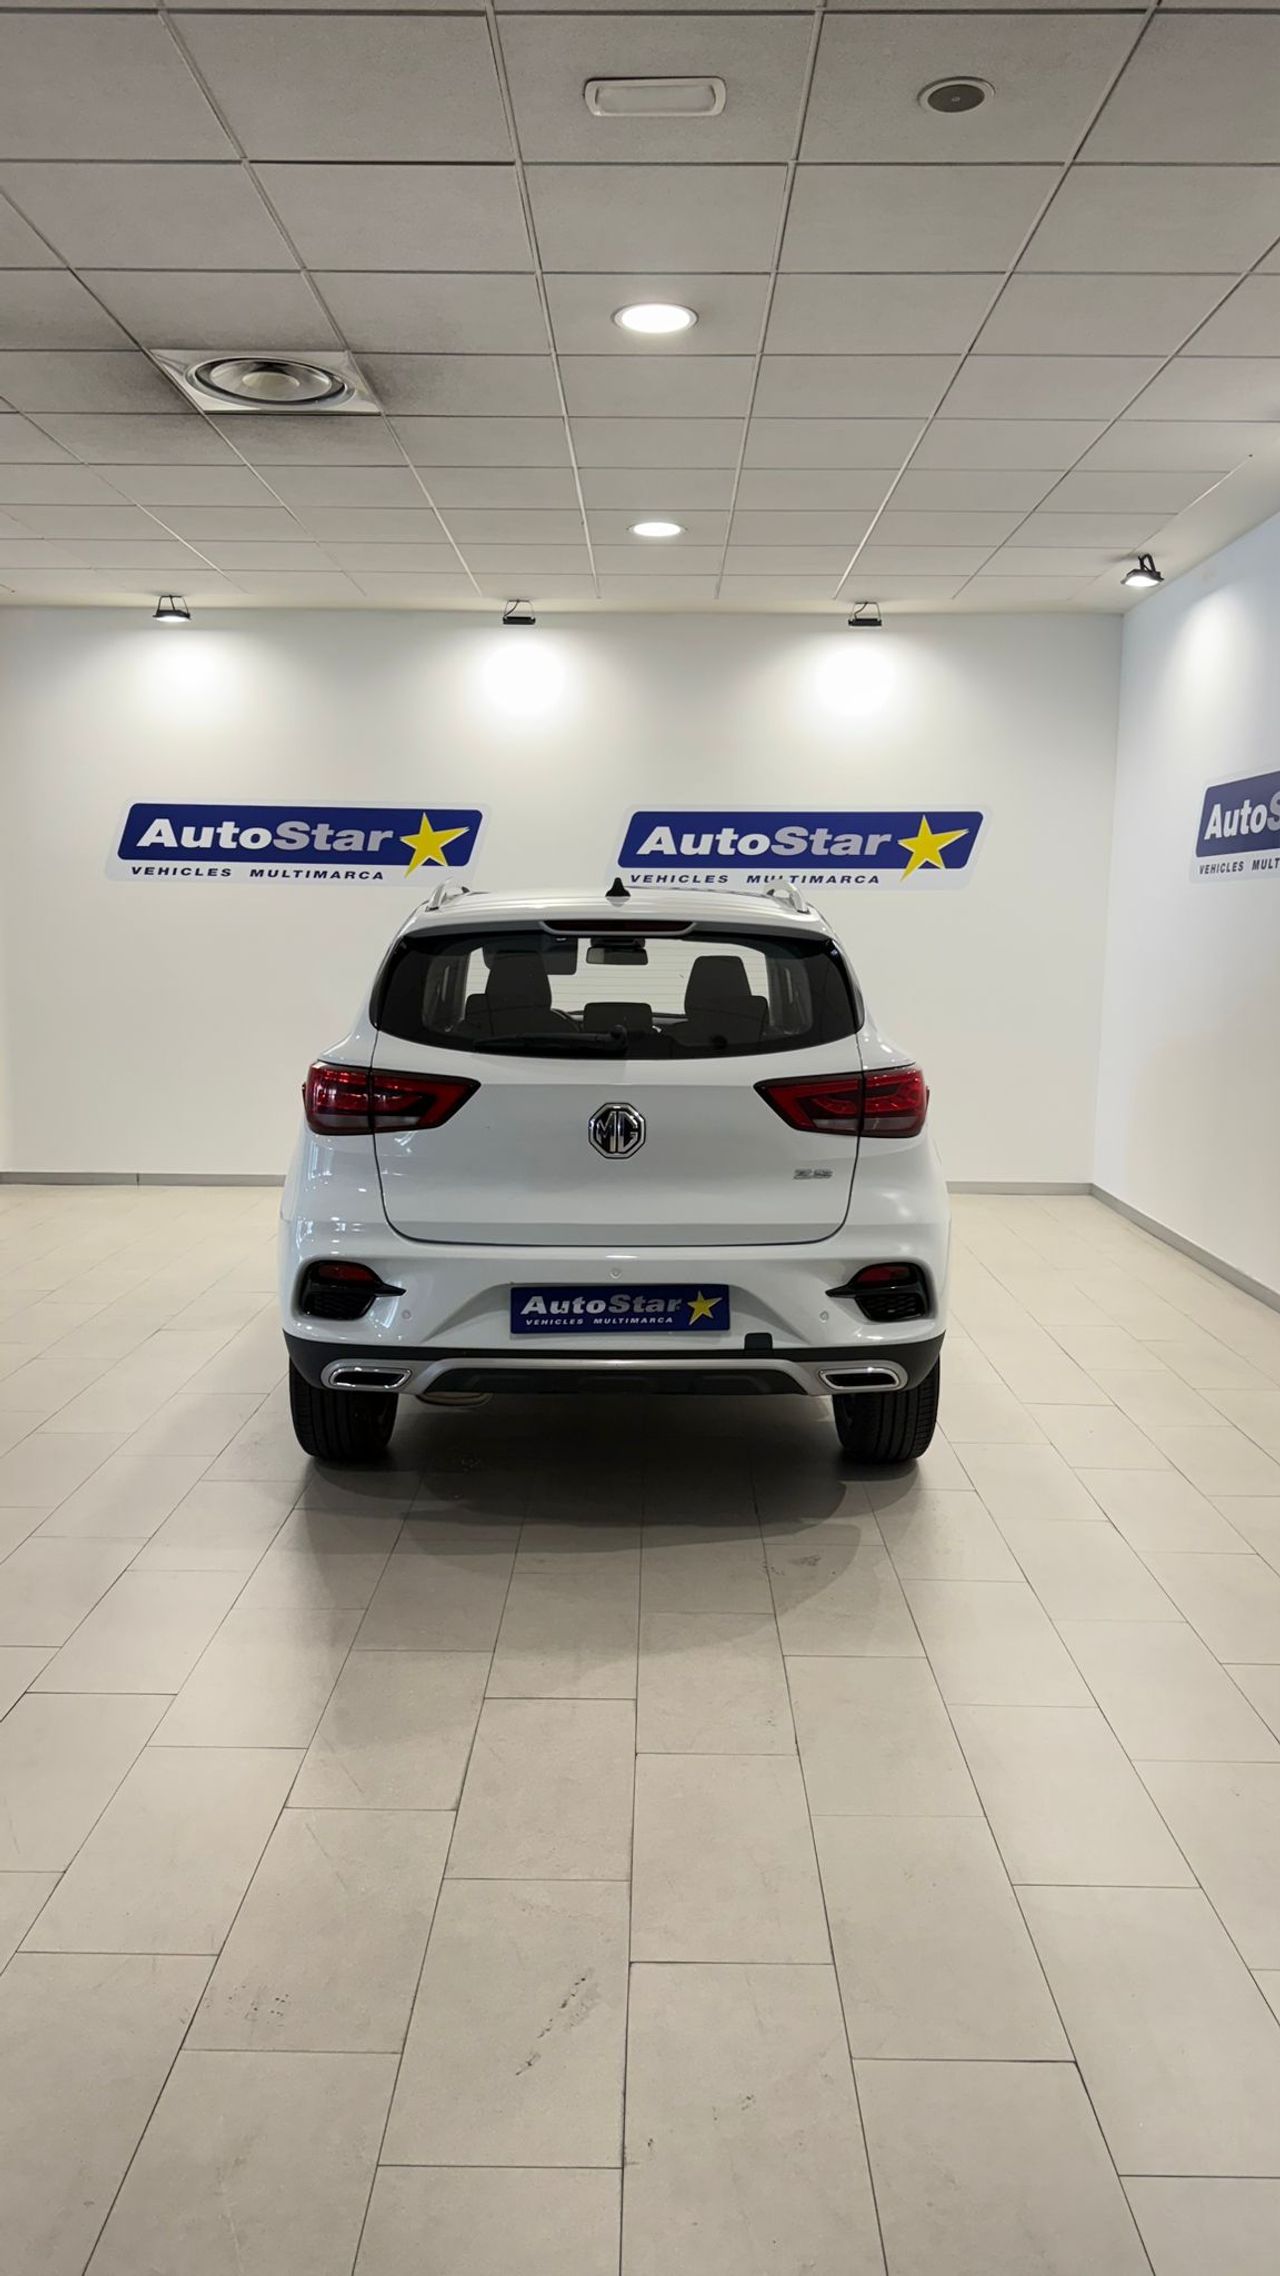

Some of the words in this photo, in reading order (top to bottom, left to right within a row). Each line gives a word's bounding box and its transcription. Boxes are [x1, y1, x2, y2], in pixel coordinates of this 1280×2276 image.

[136, 817, 394, 852] AutoStar
[636, 825, 892, 857] AutoStar
[131, 866, 232, 877] VEHICLES
[249, 868, 384, 880] MULTIMARCA
[1199, 860, 1244, 875] VEHICLES
[630, 874, 729, 884] VEHICLES
[746, 875, 880, 884] MUTIMARCA
[595, 1110, 639, 1153] MG
[520, 1294, 682, 1315] AutoStar
[593, 1316, 673, 1325] MULTIMARCA
